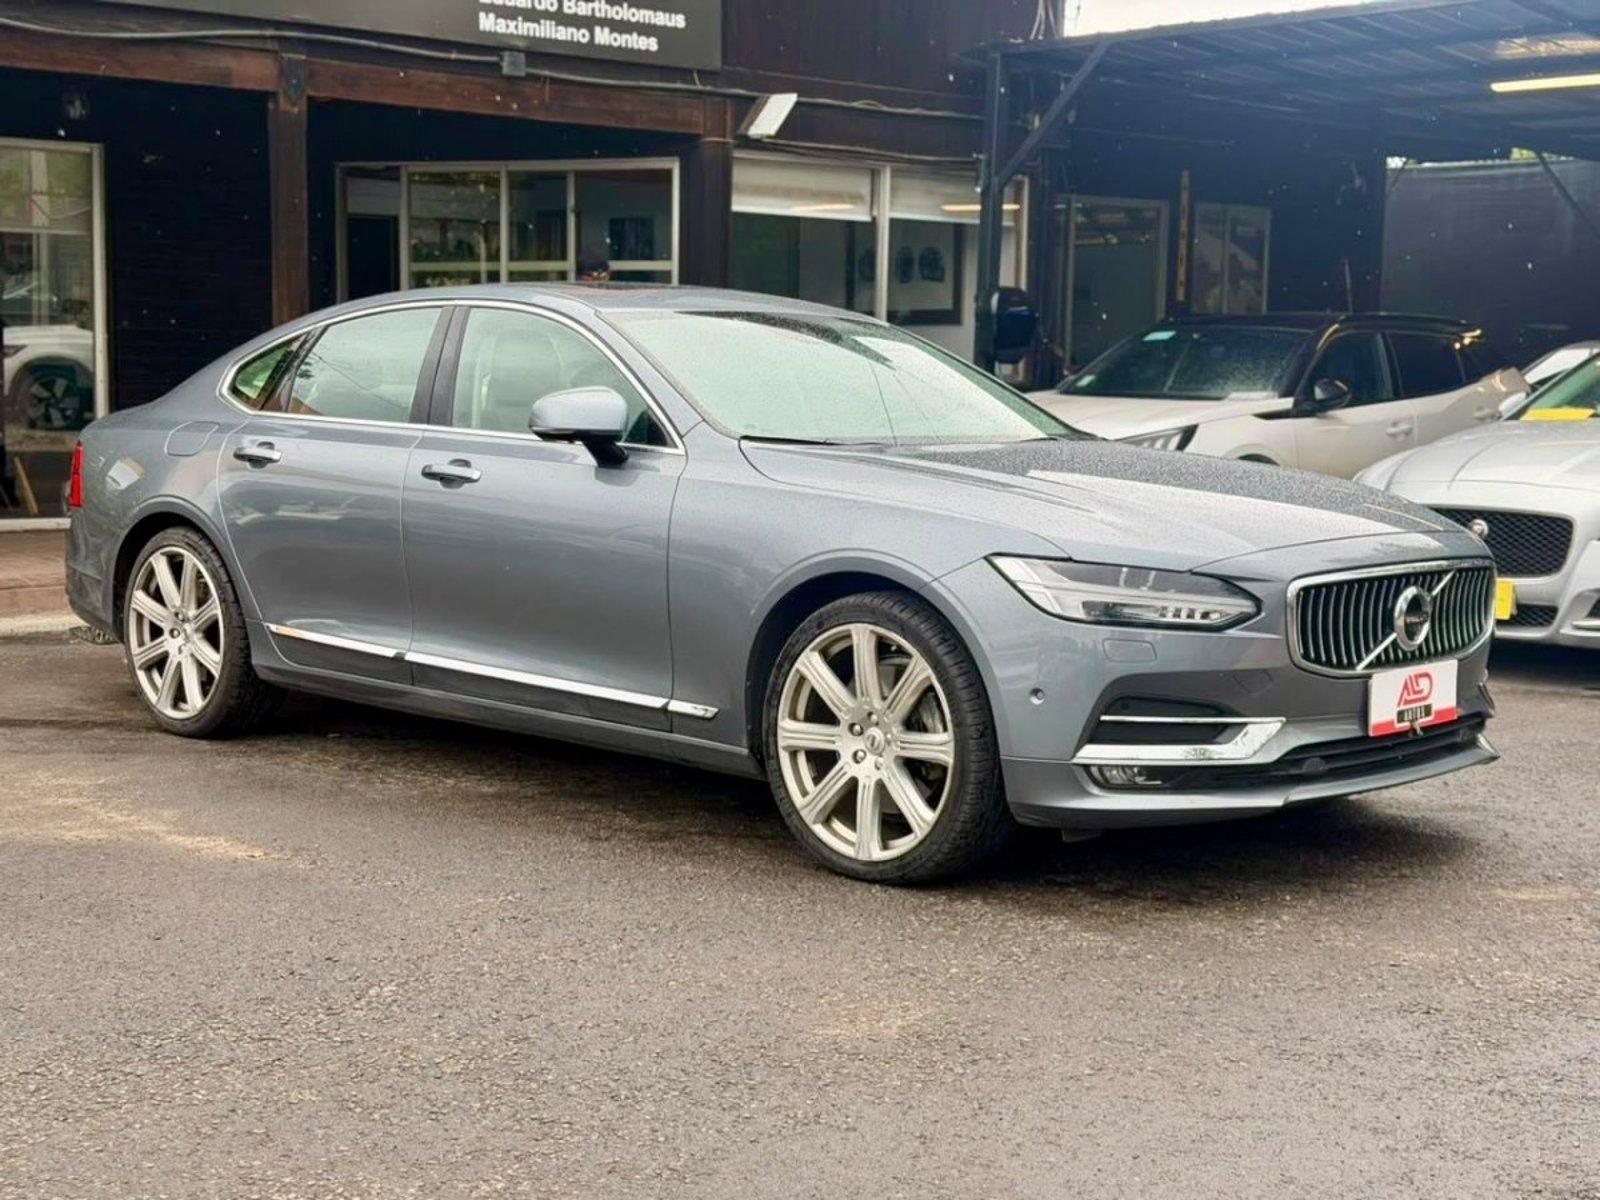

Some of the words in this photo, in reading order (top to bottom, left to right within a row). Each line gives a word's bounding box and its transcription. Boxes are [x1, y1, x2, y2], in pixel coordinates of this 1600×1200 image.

[479, 0, 559, 12] ardo
[563, 0, 686, 28] Bartholomaus
[479, 12, 590, 43] Maximiliano
[594, 26, 659, 51] Montes
